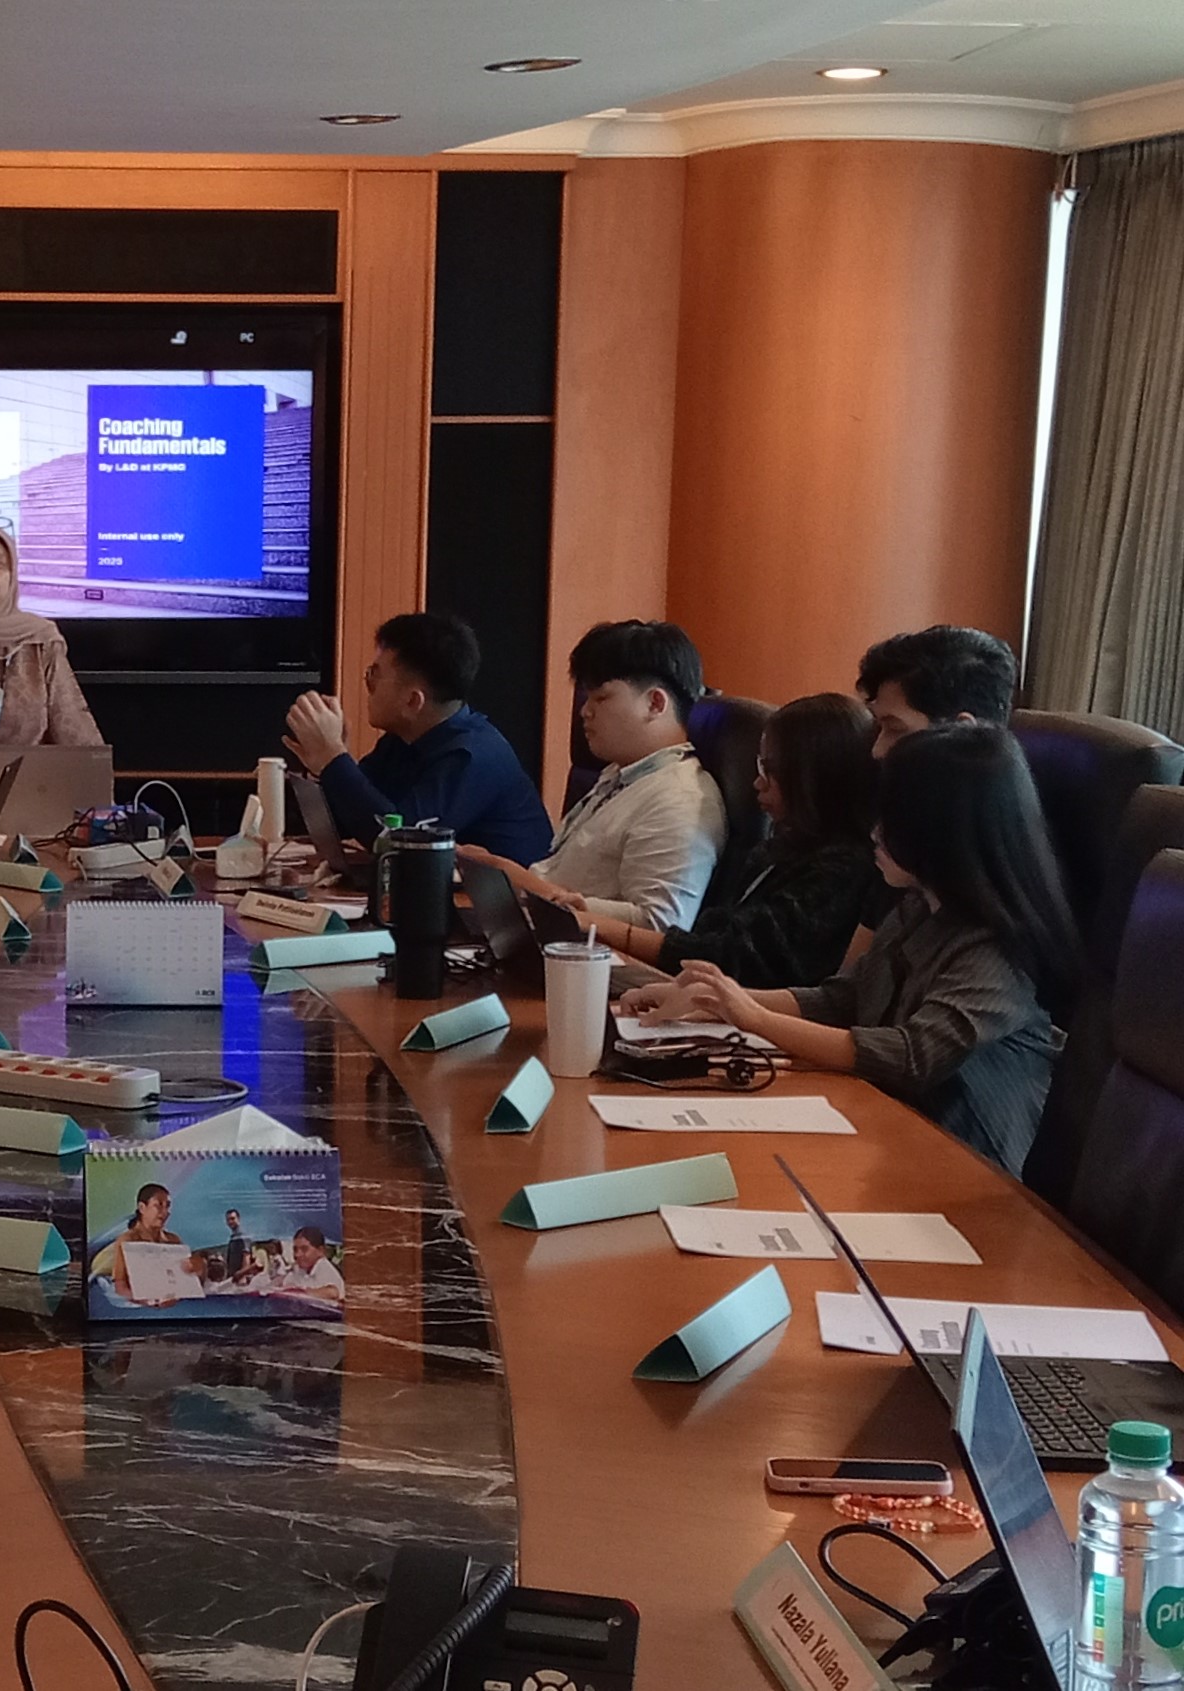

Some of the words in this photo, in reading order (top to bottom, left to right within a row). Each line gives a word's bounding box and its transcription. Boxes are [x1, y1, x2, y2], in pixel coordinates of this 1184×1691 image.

[239, 332, 255, 344] PC
[98, 417, 184, 438] Coaching
[98, 437, 227, 456] Fundamentals
[98, 463, 113, 473] By
[115, 463, 139, 472] L&D
[140, 463, 151, 472] at
[152, 463, 187, 472] KPMG
[98, 532, 138, 541] Internal
[139, 532, 160, 541] use
[161, 532, 186, 543] only
[777, 1592, 815, 1645] Nazala
[808, 1633, 850, 1691] Yuliana
